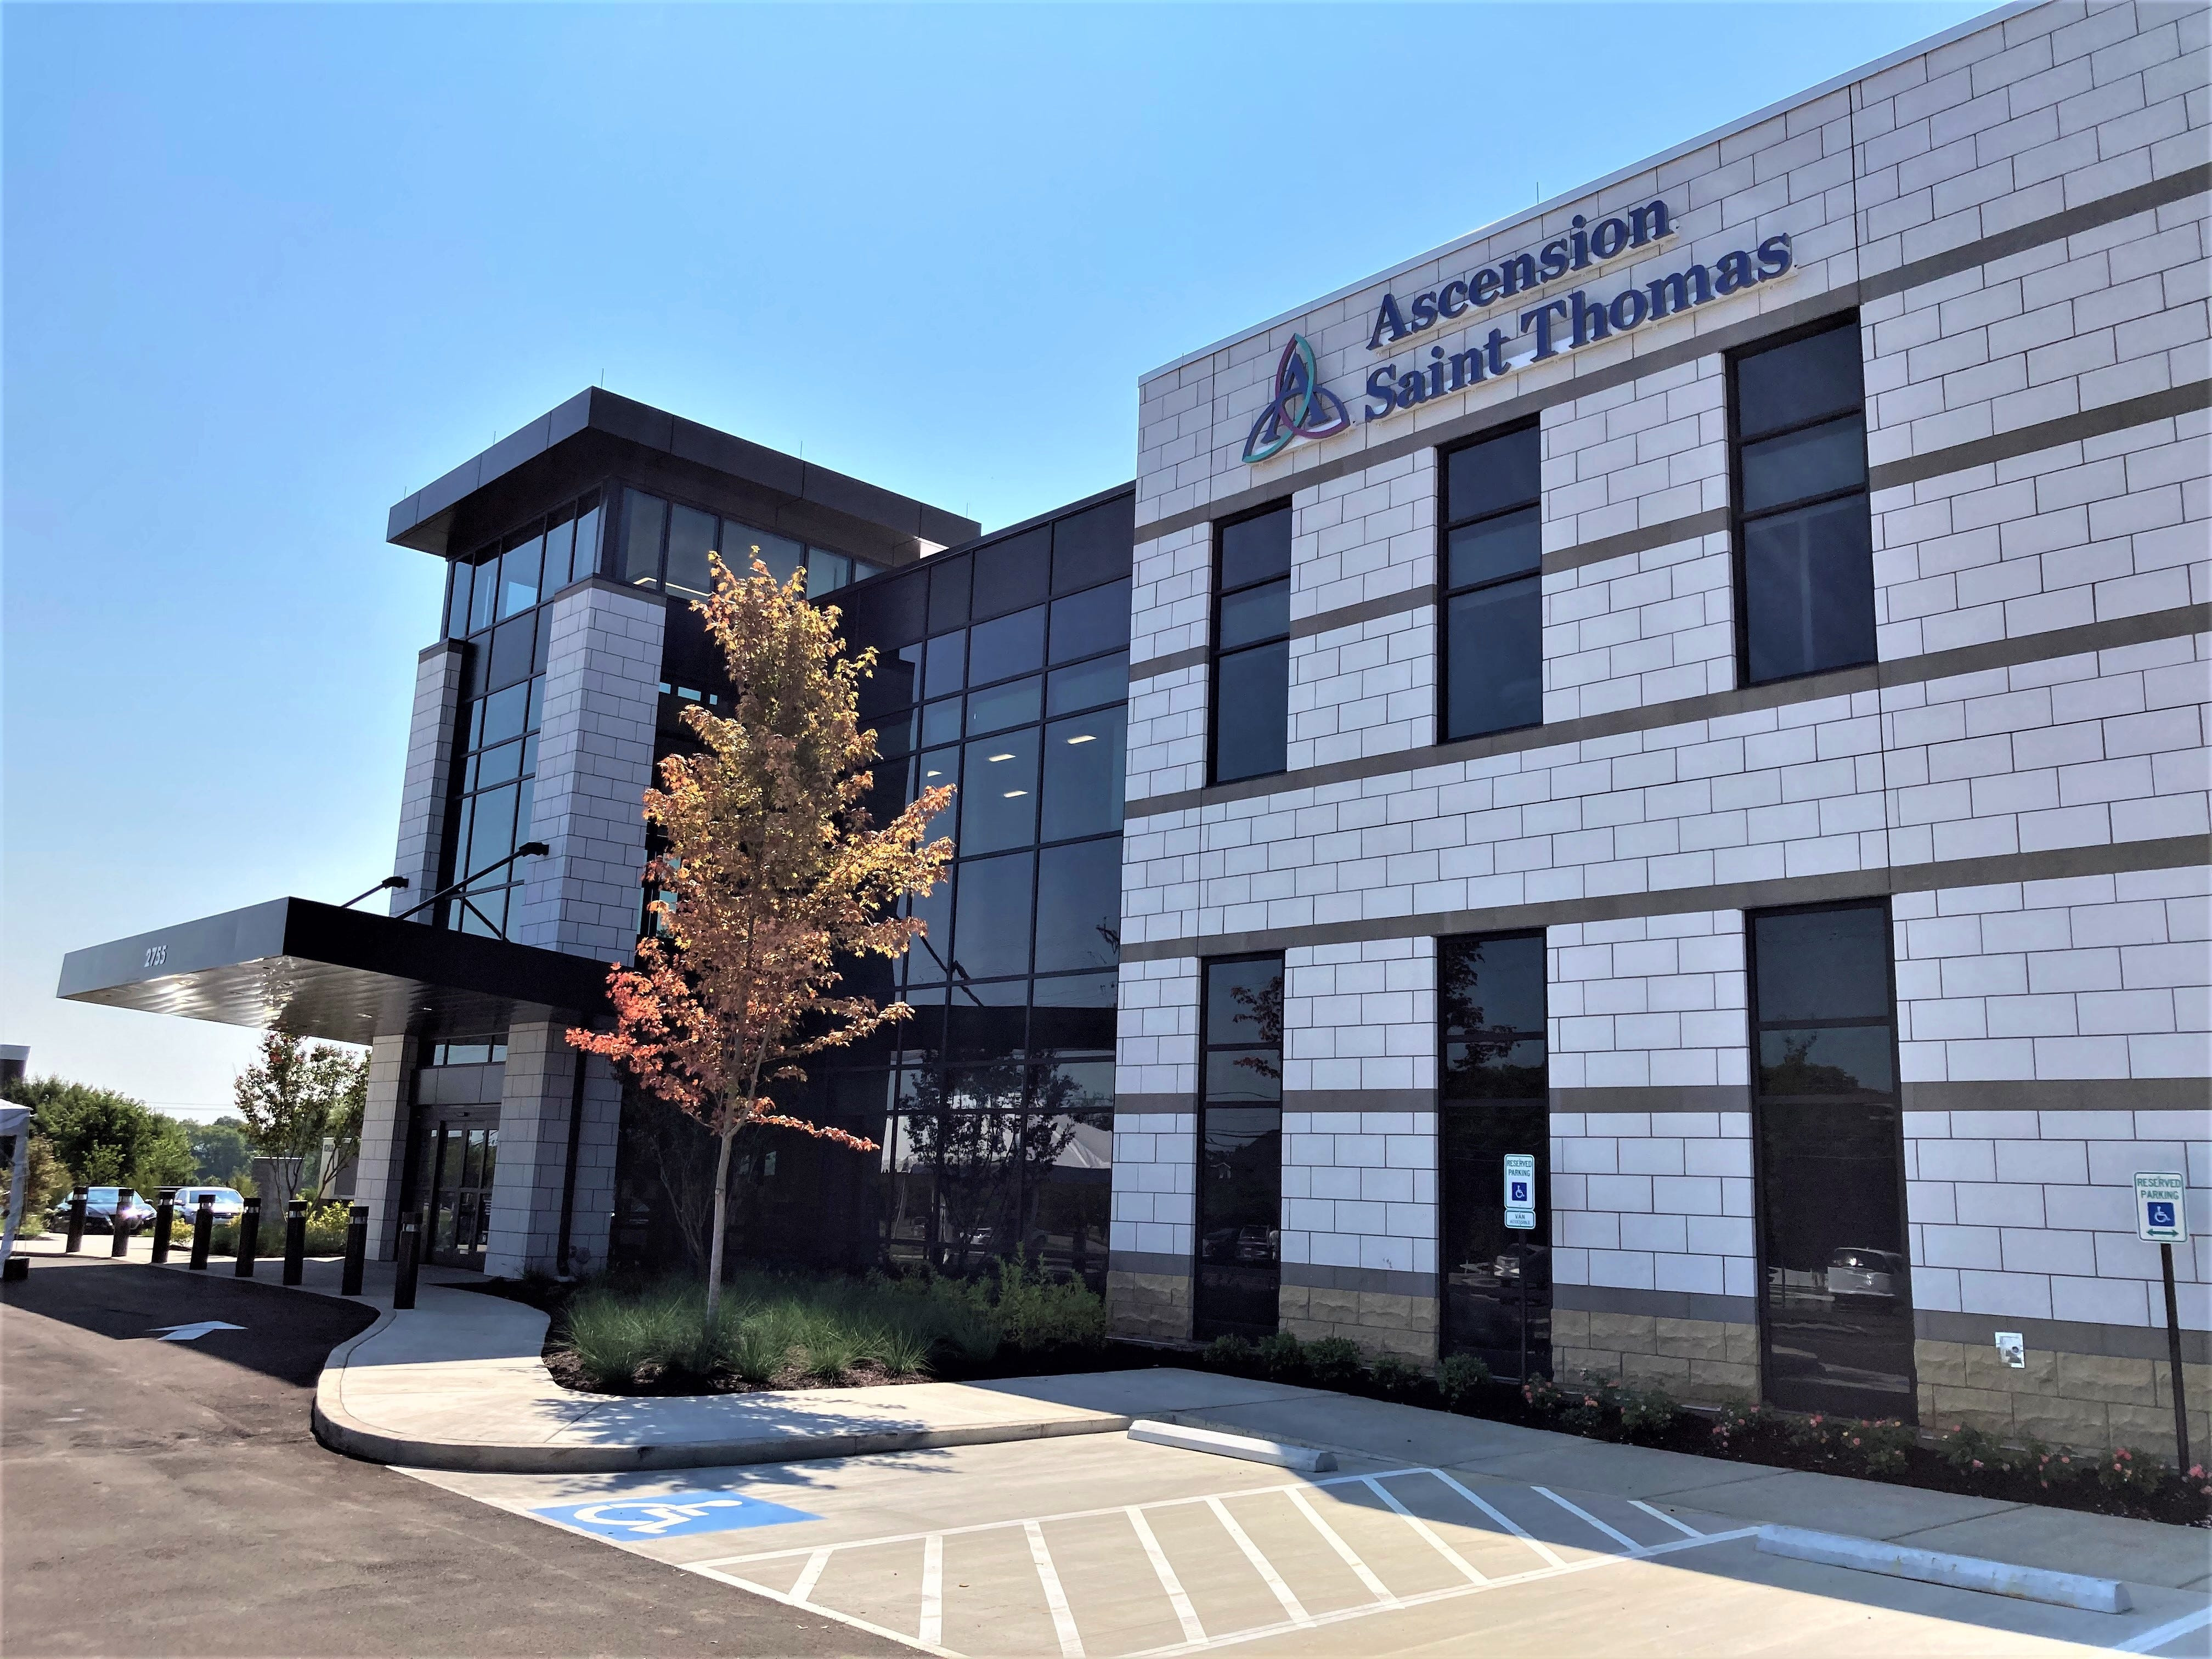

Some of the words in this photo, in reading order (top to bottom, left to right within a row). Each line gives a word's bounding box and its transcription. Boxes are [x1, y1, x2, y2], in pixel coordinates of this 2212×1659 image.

[1366, 200, 1672, 351] Ascension
[1365, 326, 1510, 421] Saint
[1521, 233, 1793, 362] Thomas
[2137, 1178, 2182, 1188] RESERVED
[2141, 1190, 2180, 1200] PARKING
